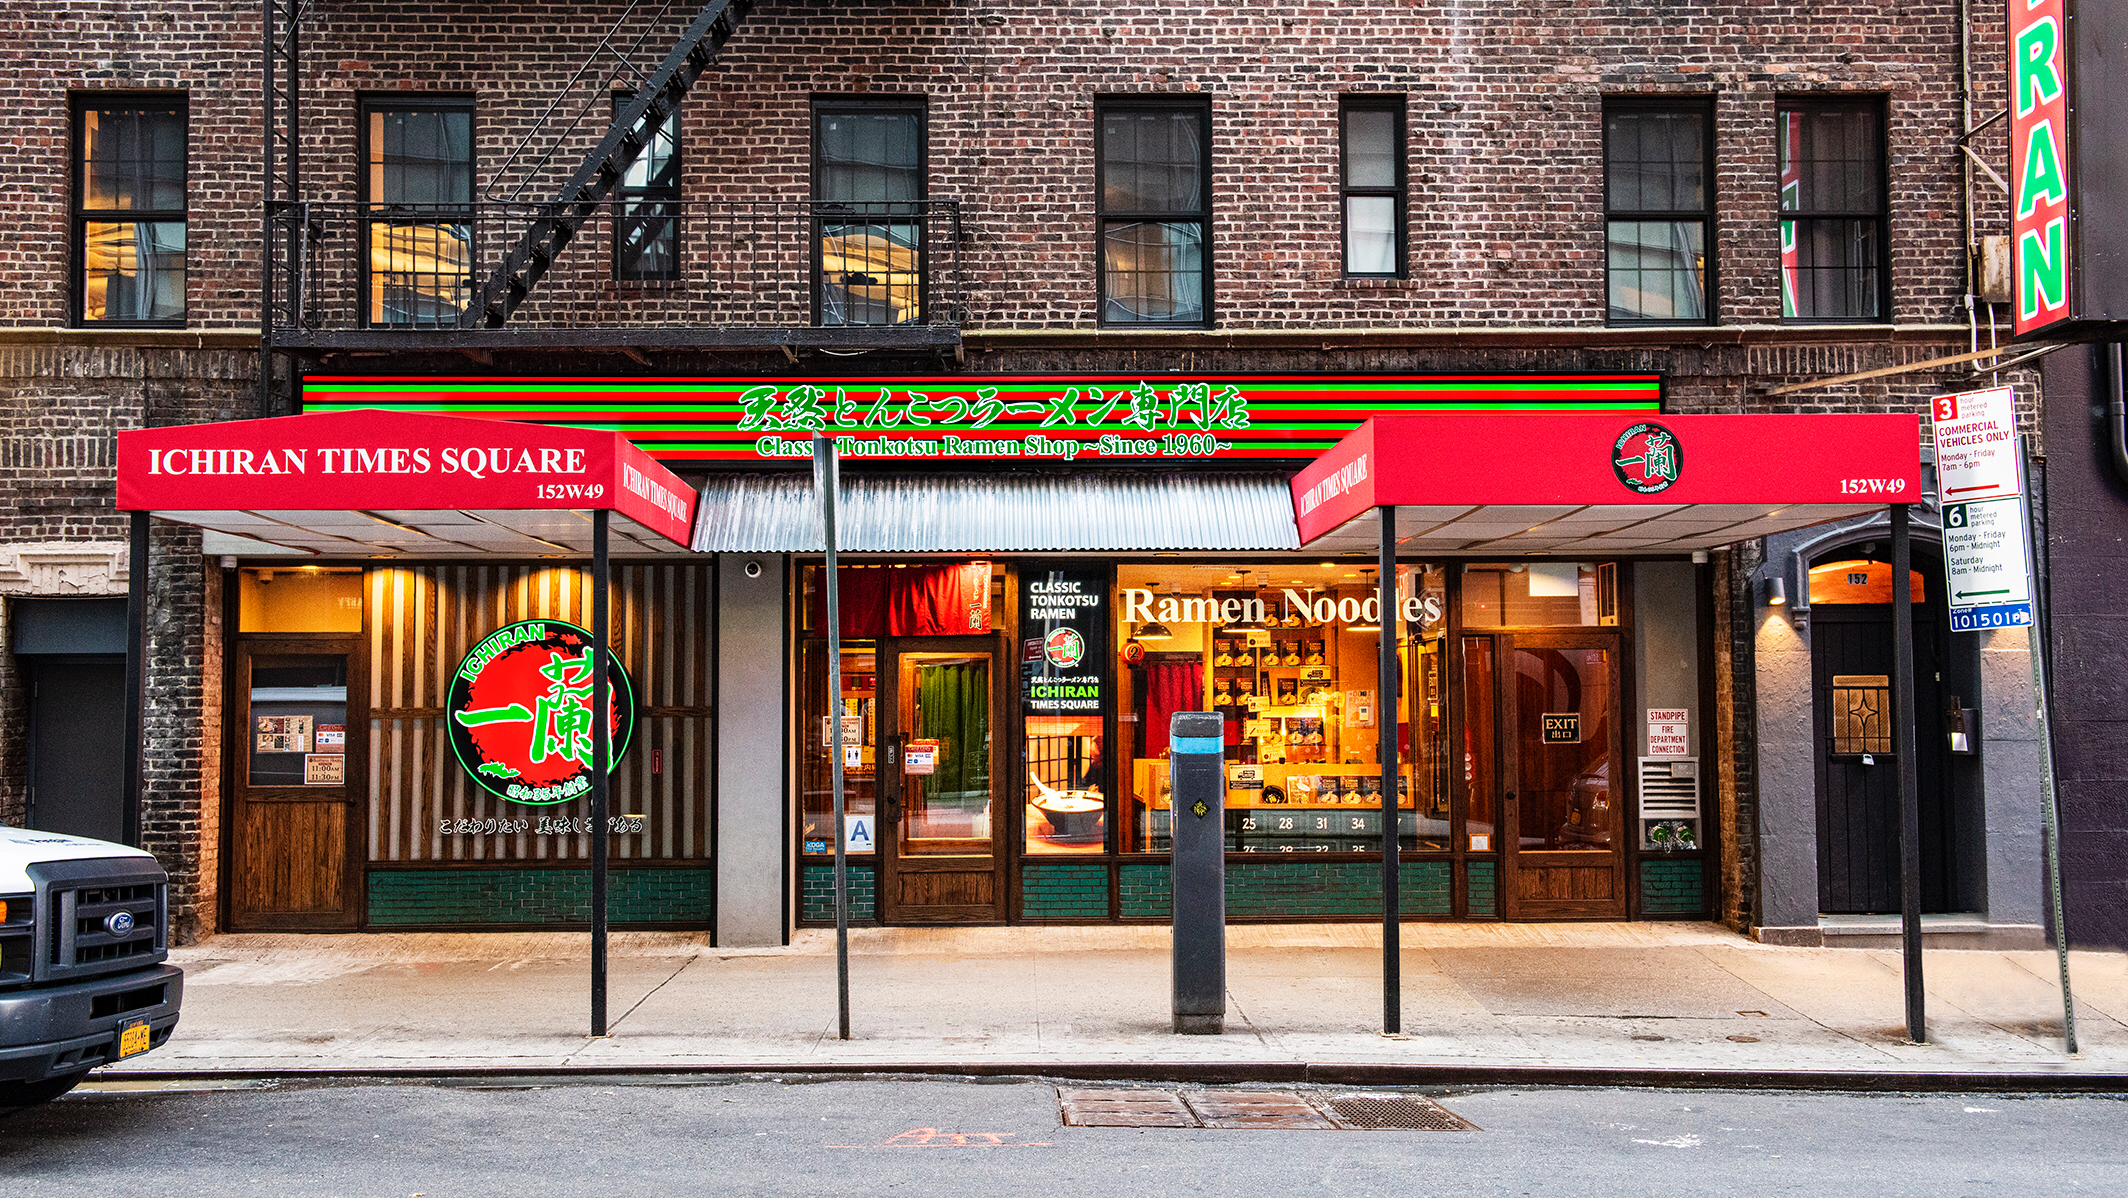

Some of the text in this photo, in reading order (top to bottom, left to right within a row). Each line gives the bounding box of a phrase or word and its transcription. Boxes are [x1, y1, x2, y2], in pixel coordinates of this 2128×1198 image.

[737, 380, 1250, 431] 天然とんこつラーメン専門店
[1939, 399, 1953, 419] 3
[1961, 402, 1987, 411] metered
[1962, 410, 1985, 419] parking
[1939, 420, 1999, 437] COMMERCIAL
[1940, 430, 2009, 448] VEHICLES ONLY
[757, 436, 814, 456] Class
[836, 436, 937, 456] Tonkotsu
[942, 436, 1019, 456] Ramen
[1025, 435, 1079, 460] Shop
[1941, 452, 1968, 462] Monday
[1974, 449, 1995, 458] Friday
[148, 446, 586, 480] ICHIRAN TIMES SQUARE
[1942, 463, 1957, 471] 7am
[1964, 460, 1980, 470] 6pm
[1300, 453, 1367, 518] ICHIRAN TIMES SQUARE
[1839, 477, 1905, 496] 152W49
[537, 484, 604, 500] 152W49
[623, 462, 687, 523] ICHIRAN TIMES SQUARE
[1949, 506, 1962, 527] 6
[1971, 511, 1997, 520] metered
[1971, 519, 1995, 527] parking
[1948, 533, 1977, 543] Monday
[1983, 530, 2006, 539] Friday
[1949, 544, 1966, 553] 6pm
[1971, 540, 2001, 551] Midnight
[1951, 557, 1983, 567] Saturday
[1952, 567, 1968, 575] 8am
[1973, 564, 2003, 573] Midnight
[1848, 574, 1867, 585] 152
[1030, 582, 1081, 593] CLASSIC
[1030, 595, 1099, 606] TONKOTSU
[1121, 588, 1442, 623] Ramen Noodles
[1030, 608, 1076, 619] RAMEN
[1953, 612, 2010, 628] 101501
[460, 623, 545, 683] ICHIRAN
[1130, 646, 1139, 659] 2
[1030, 686, 1099, 698] ICHIRAN
[1030, 700, 1099, 710] TIMES SQUARE
[1650, 711, 1685, 720] STANDPIPE
[1545, 719, 1577, 729] EXIT
[1661, 726, 1674, 734] FIRE
[1552, 730, 1572, 738] 出口
[1650, 736, 1686, 744] DEPARTMENT
[1651, 745, 1685, 753] CONNECTION
[439, 818, 529, 835] こだわりたい
[1242, 818, 1256, 830] 25
[1279, 818, 1293, 830] 28
[1316, 818, 1328, 830] 31
[1351, 818, 1365, 830] 34
[850, 820, 869, 841] A
